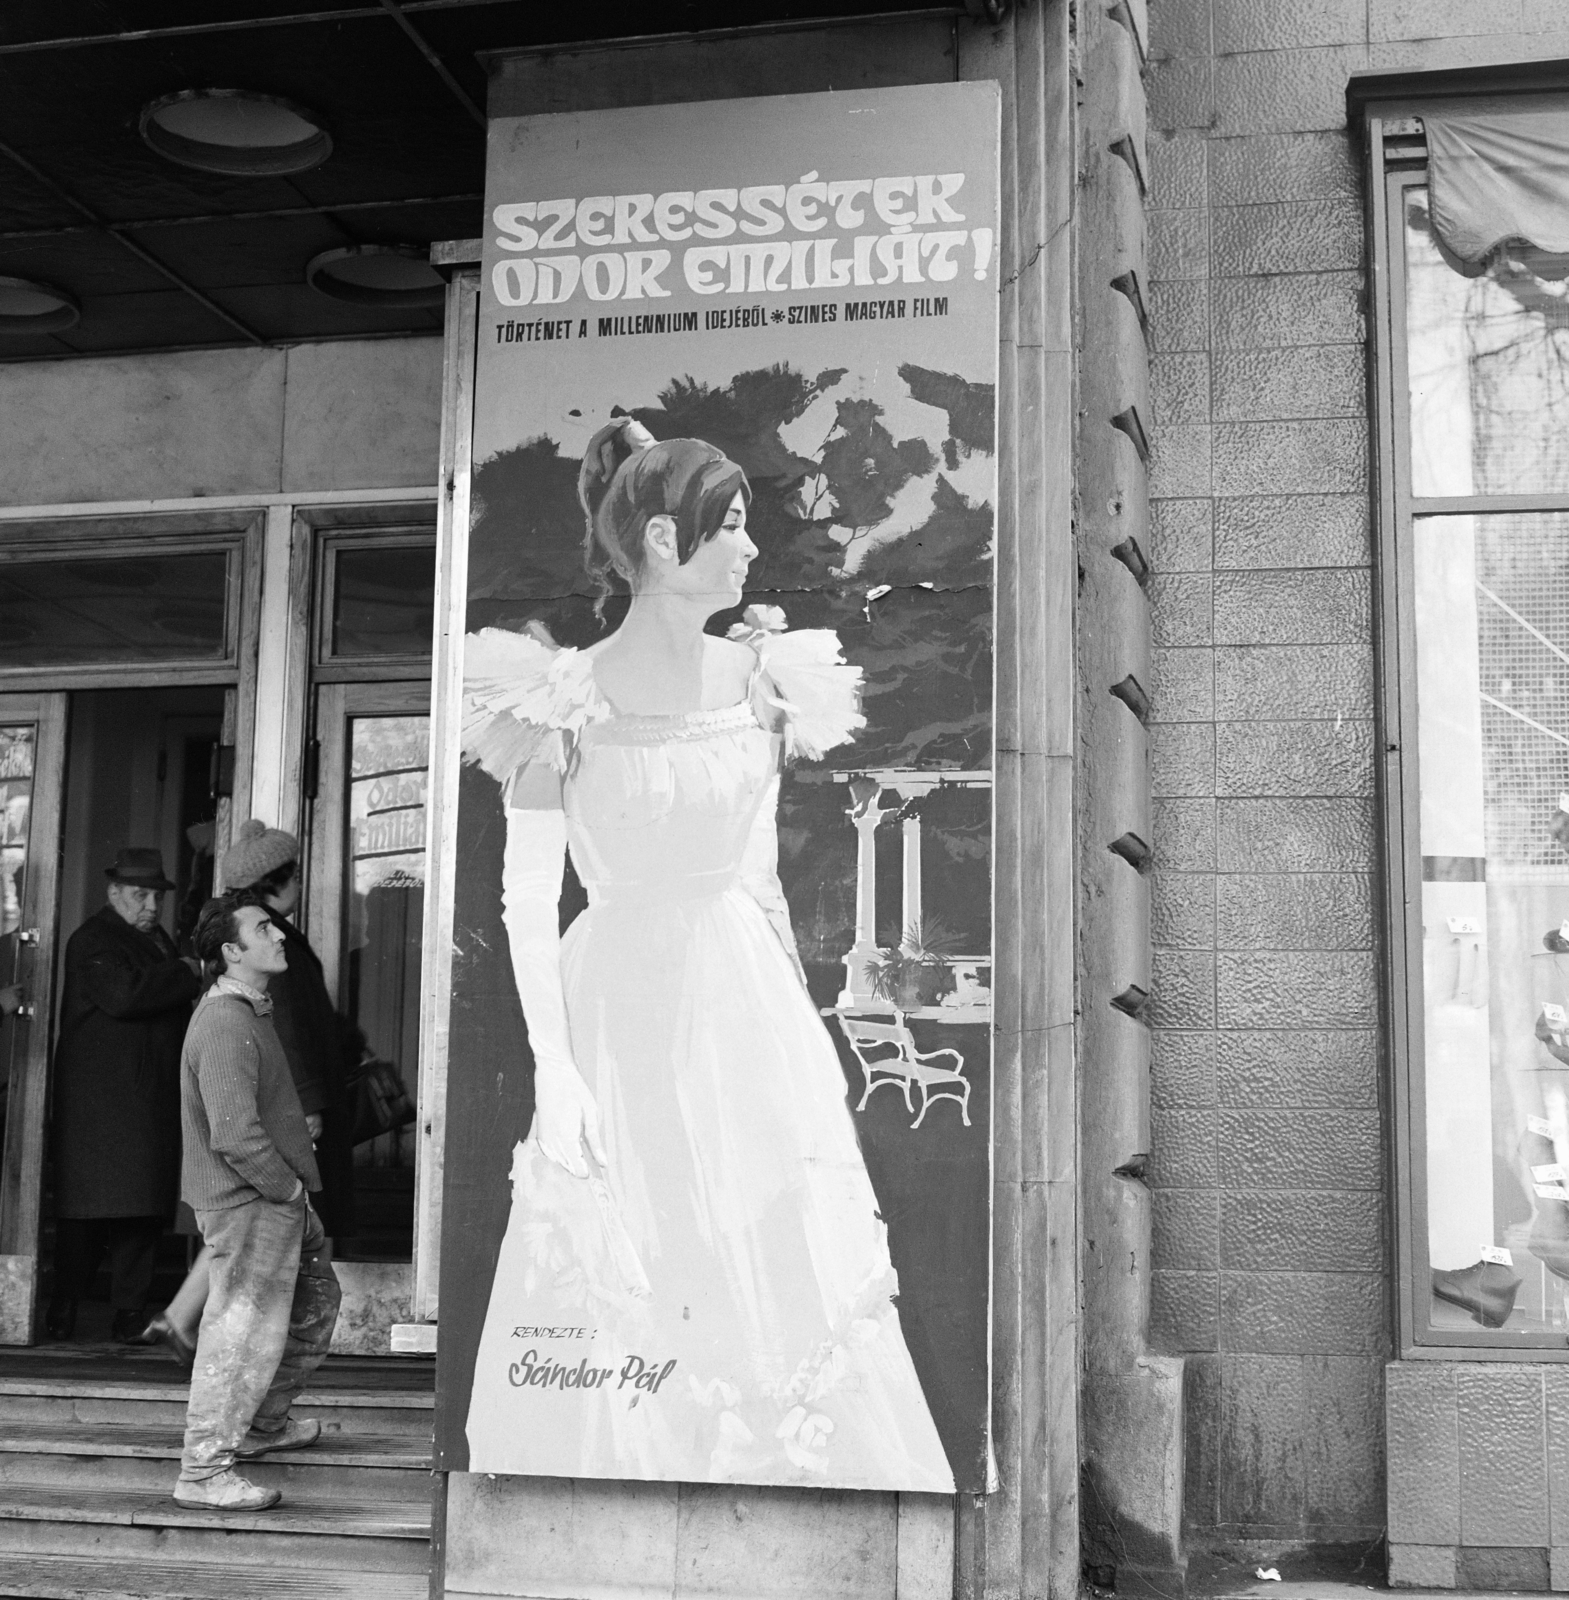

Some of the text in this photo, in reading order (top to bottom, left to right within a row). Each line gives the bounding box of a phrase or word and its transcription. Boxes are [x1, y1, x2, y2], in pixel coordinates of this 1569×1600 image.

[493, 170, 966, 251] SZERESSÉTEK
[492, 224, 993, 306] ODOR EMILIÁT!
[496, 296, 949, 343] TÖRTÉNET A MILLENNIUM IDEJÉBŐL SZINES MAGYAR FILM
[508, 1349, 678, 1395] Sándor Pál
